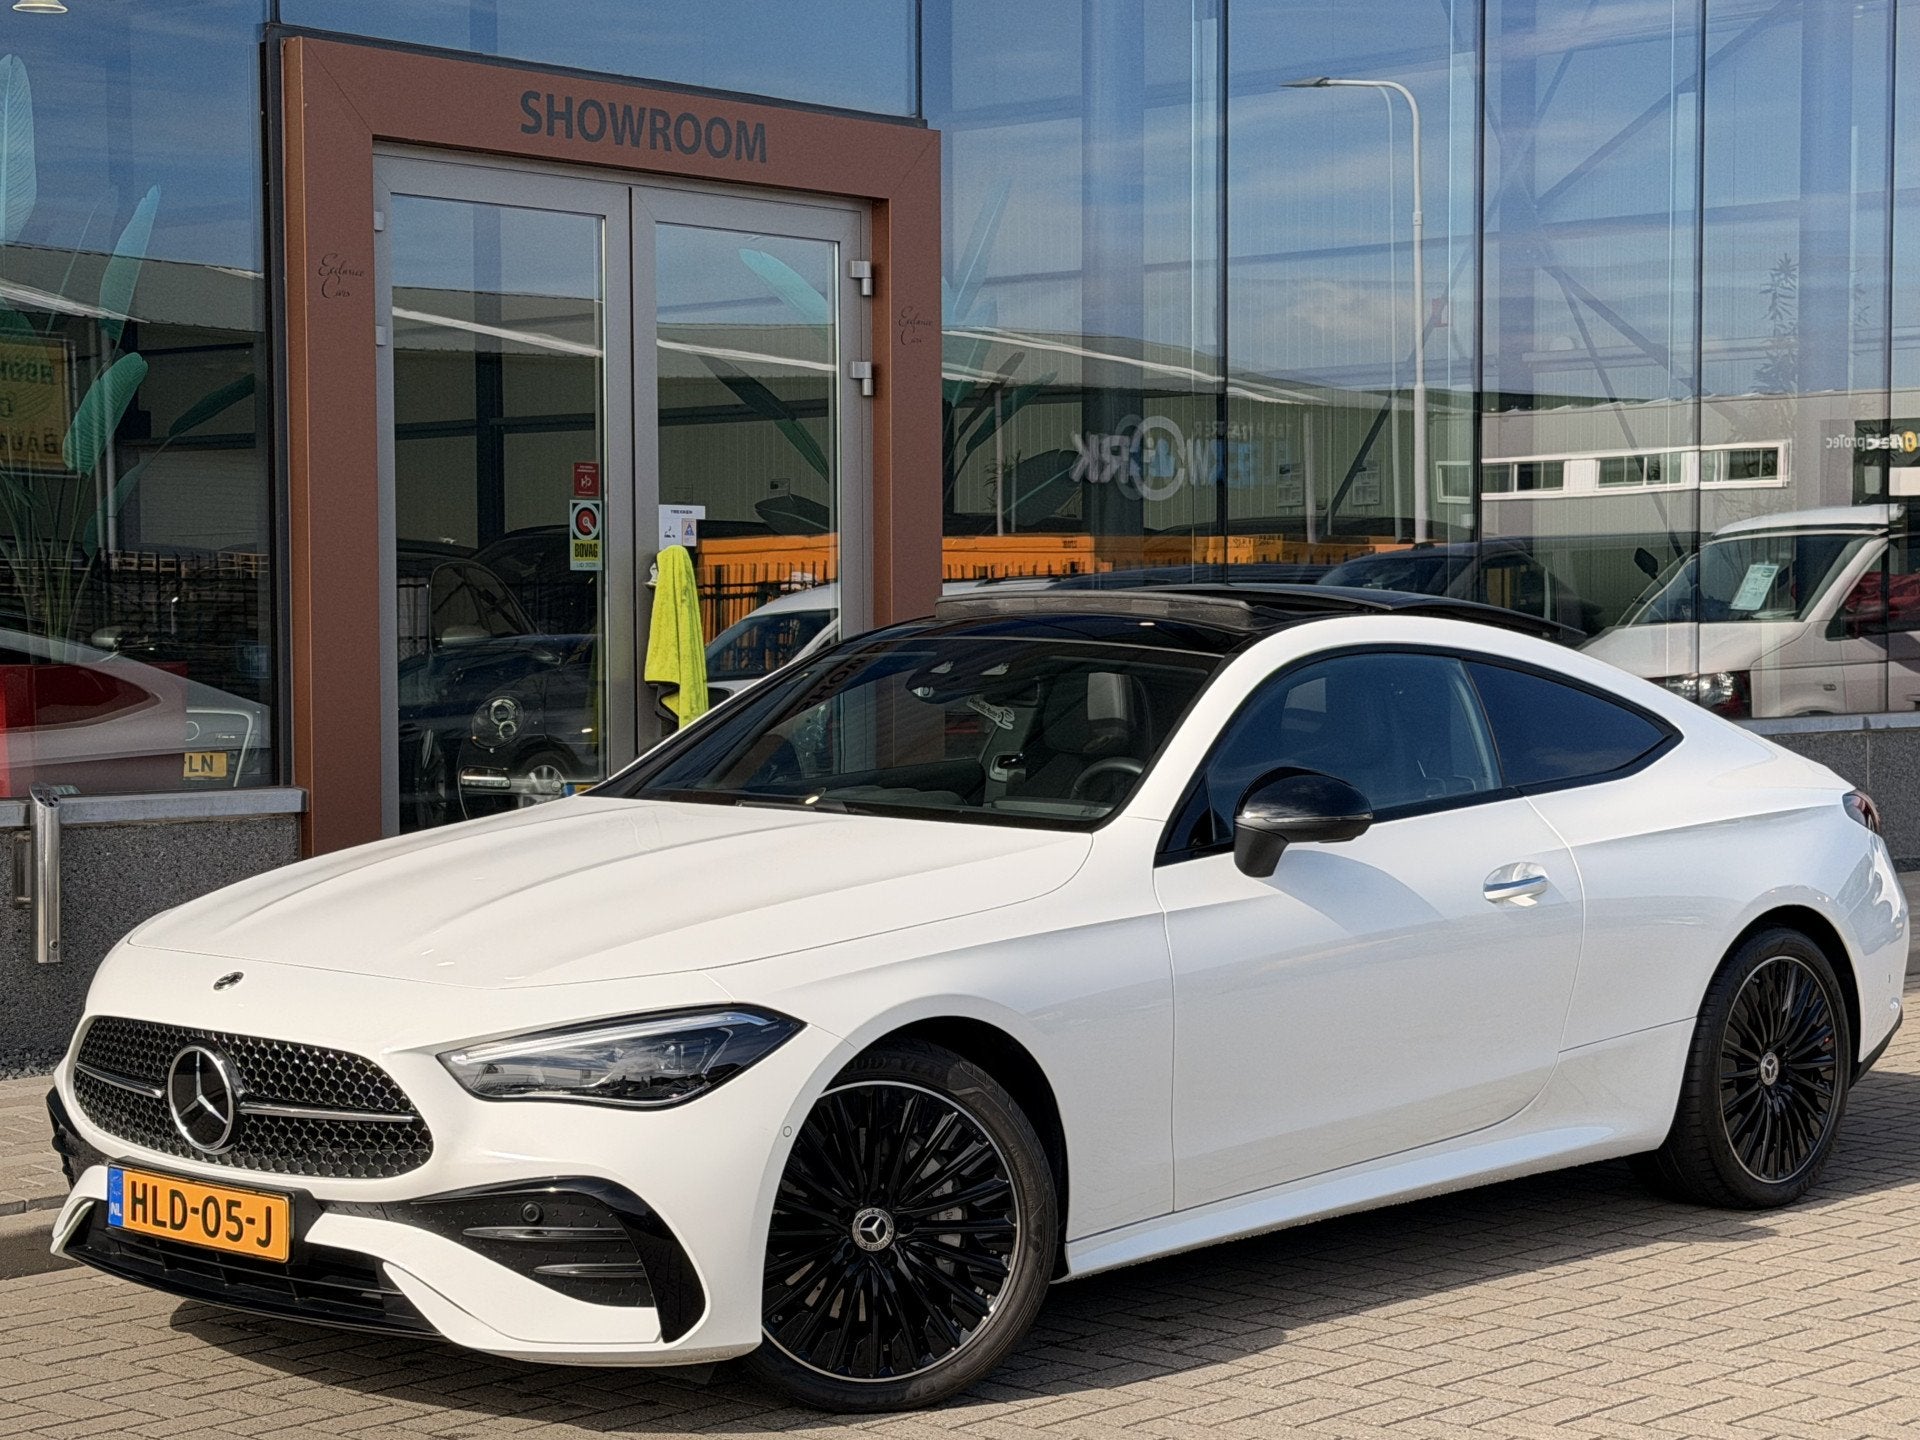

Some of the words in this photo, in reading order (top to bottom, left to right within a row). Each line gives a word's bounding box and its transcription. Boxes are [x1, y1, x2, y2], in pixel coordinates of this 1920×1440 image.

[520, 90, 768, 164] SHOWROOM
[574, 543, 598, 558] BOVAG
[189, 755, 213, 772] LN
[110, 1203, 122, 1216] NL
[131, 1181, 272, 1248] HLD-05-J
